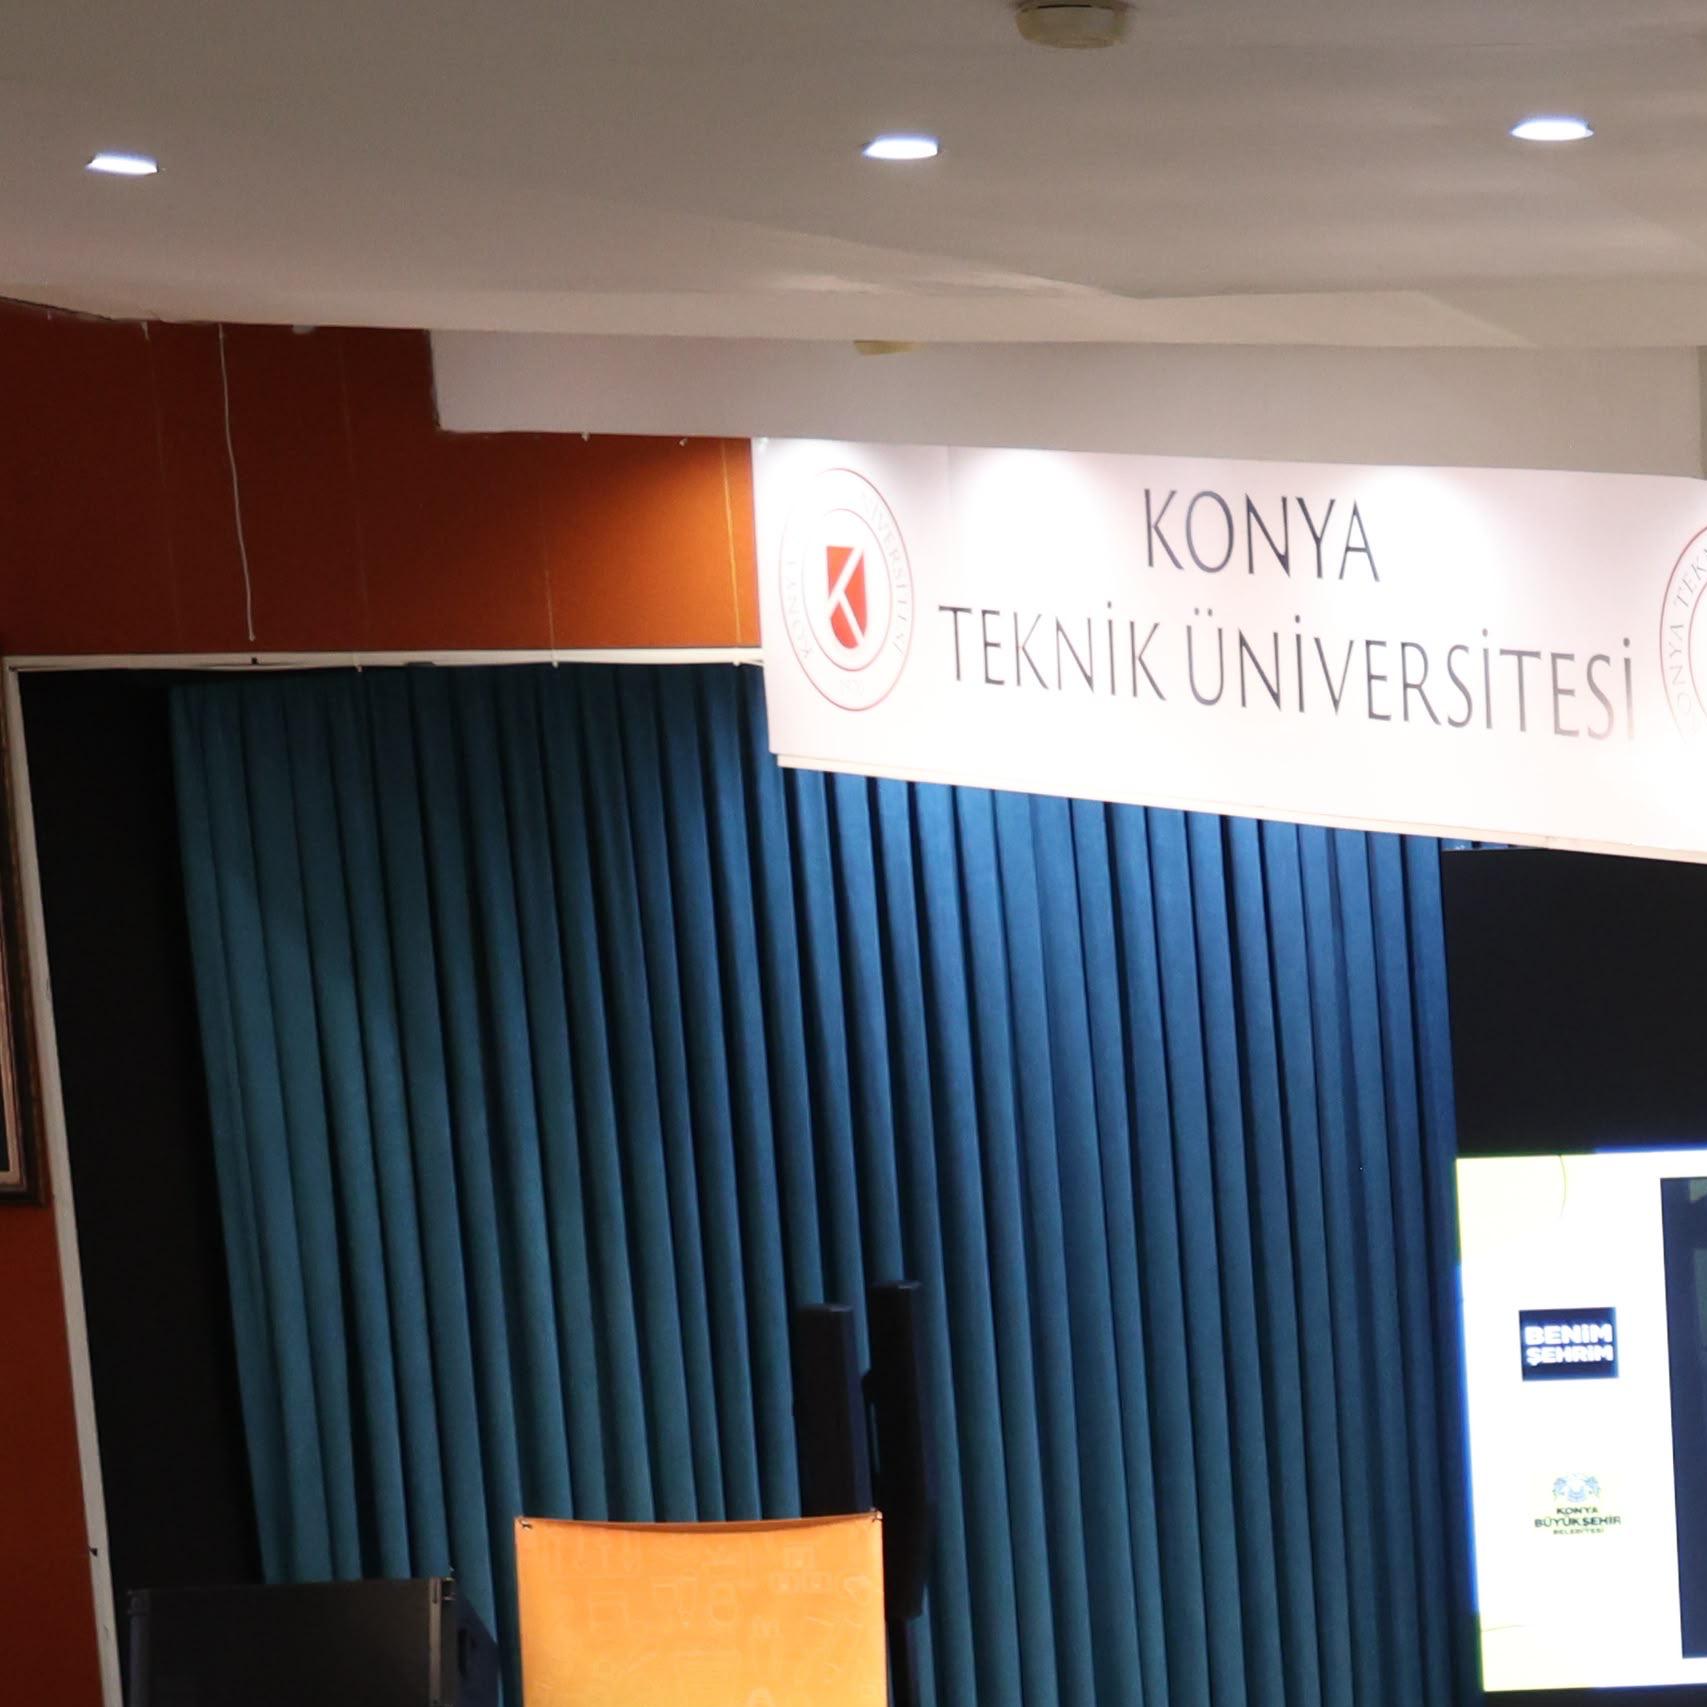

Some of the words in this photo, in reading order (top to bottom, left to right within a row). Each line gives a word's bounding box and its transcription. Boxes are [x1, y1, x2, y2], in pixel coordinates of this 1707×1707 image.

[1144, 488, 1380, 583] KONYA
[938, 600, 1166, 701] TEKNİK
[1186, 607, 1636, 740] ÜNİVERSİTESİ
